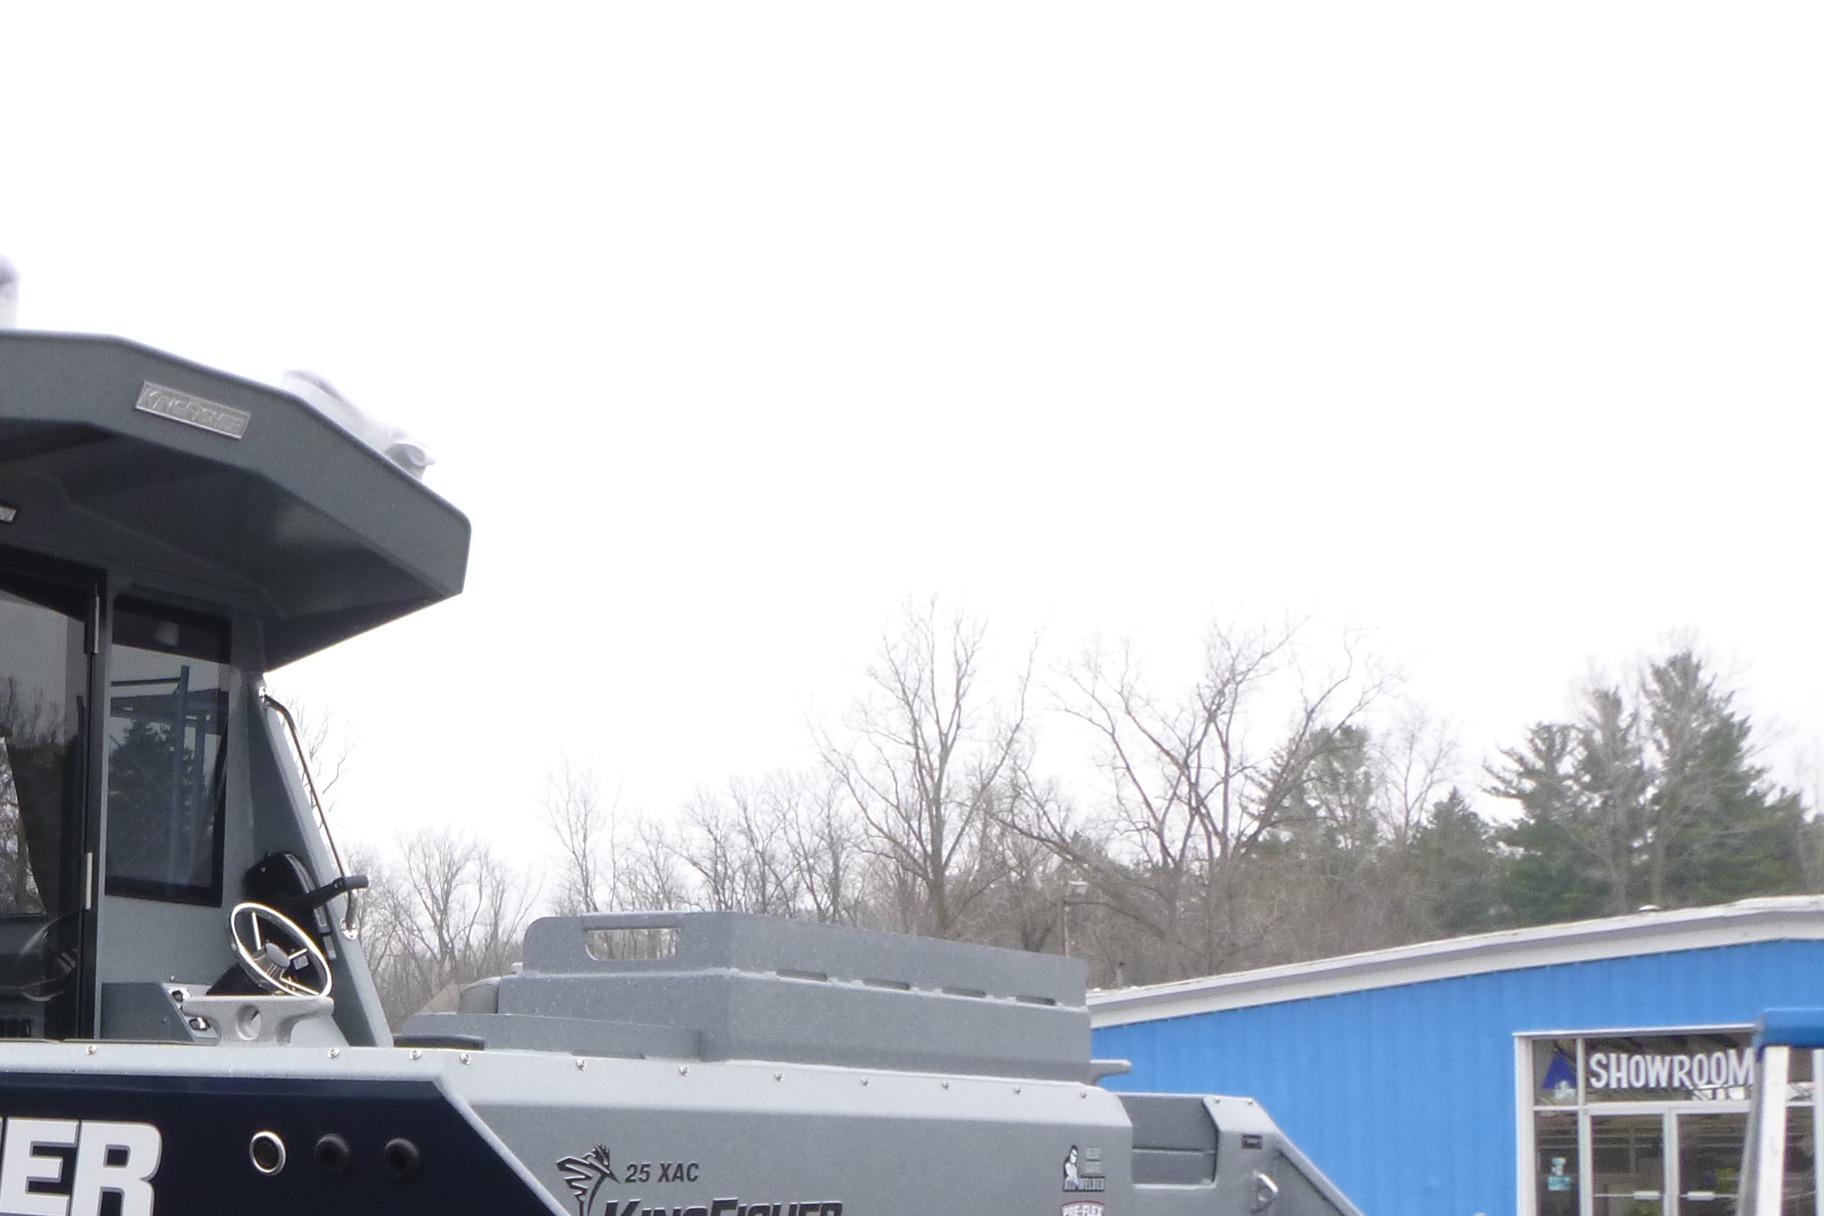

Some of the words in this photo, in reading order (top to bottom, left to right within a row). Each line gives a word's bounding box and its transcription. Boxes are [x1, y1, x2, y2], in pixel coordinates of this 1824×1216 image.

[1589, 1048, 1754, 1089] SHOWROOM
[625, 1163, 651, 1184] 25
[657, 1162, 699, 1183] XAC
